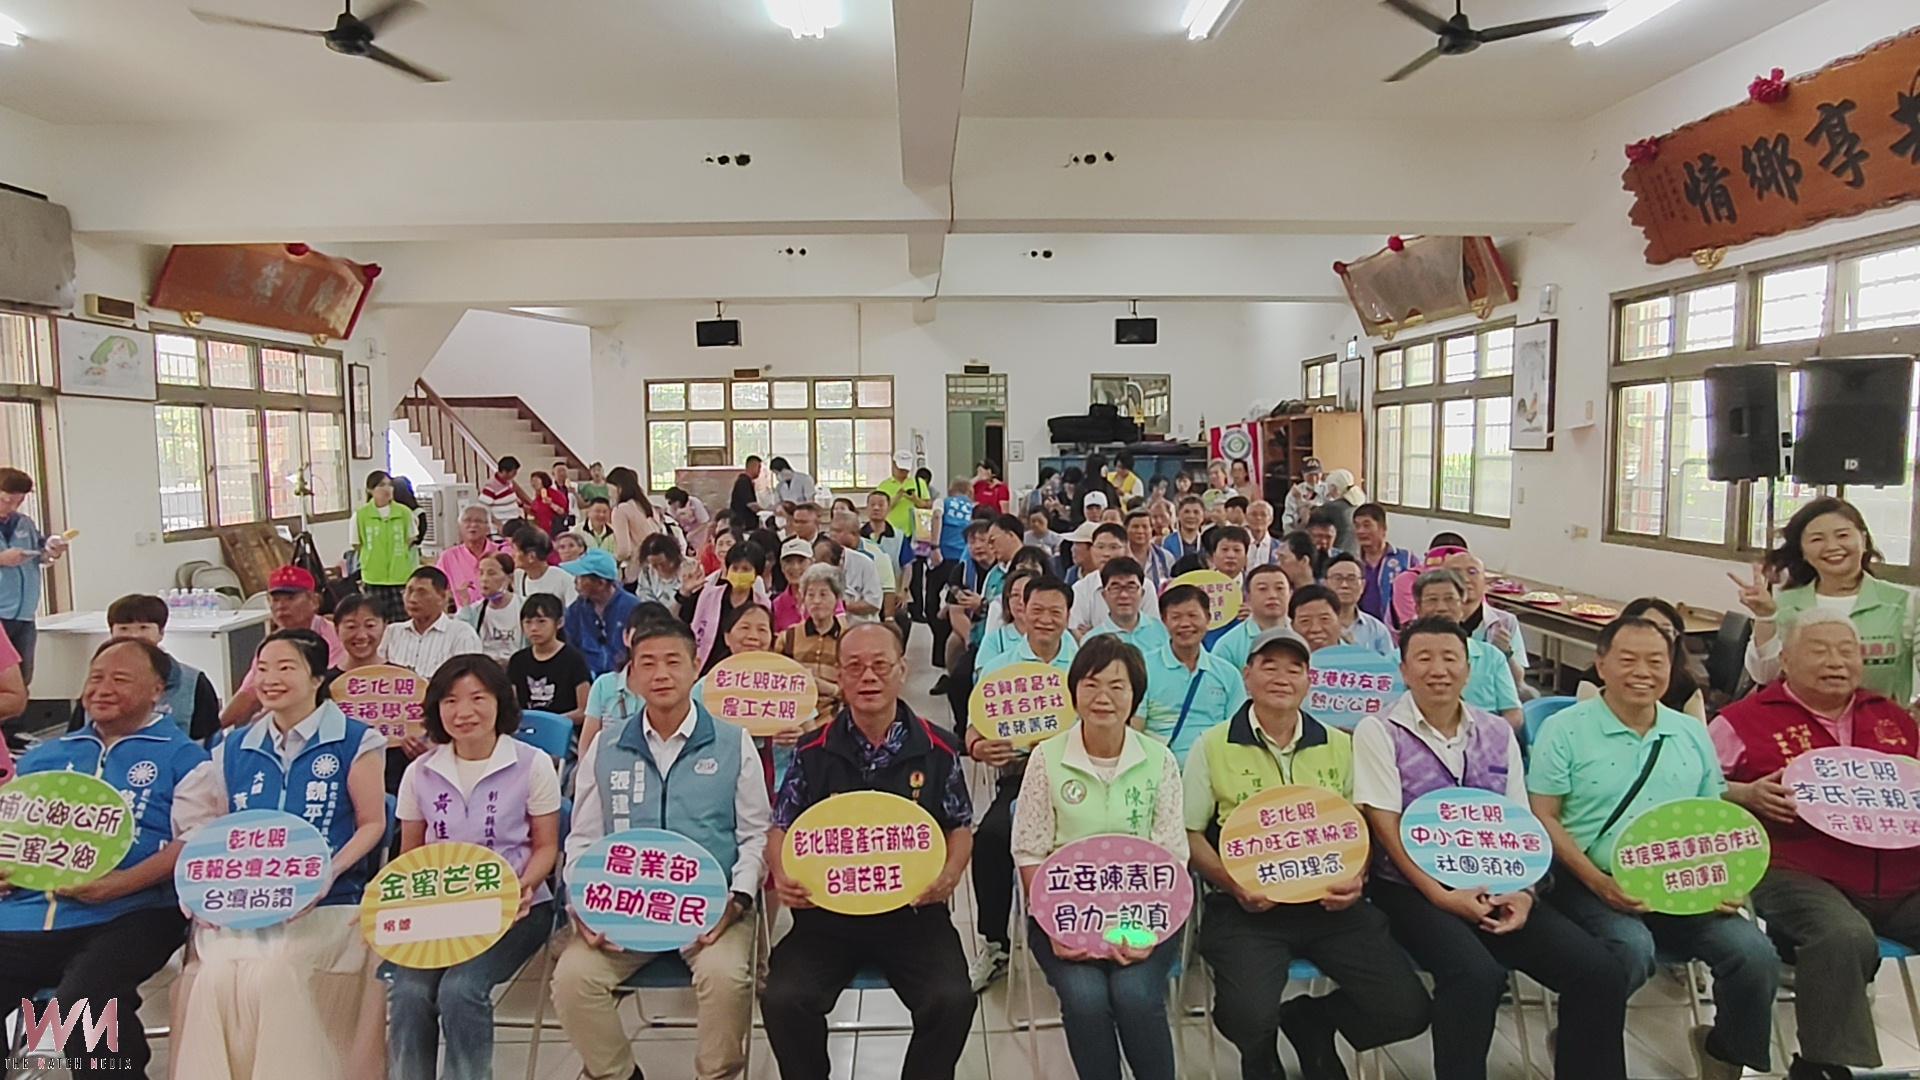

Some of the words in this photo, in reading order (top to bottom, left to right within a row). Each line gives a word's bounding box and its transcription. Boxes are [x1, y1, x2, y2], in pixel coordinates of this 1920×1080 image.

[346, 677, 415, 695] 彰化縣
[715, 669, 807, 692] 彰化縣政府
[985, 693, 1065, 718] 生產合作社
[1813, 757, 1898, 781] 彰化縣
[1259, 801, 1317, 827] 彰化縣
[1439, 802, 1504, 822] 彰化縣
[0, 832, 96, 871] 三蜜之鄉
[228, 827, 287, 850] 彰化縣
[794, 823, 931, 857] 彰化縣農產行銷協會
[1226, 821, 1359, 858] 活力旺企業協會
[1410, 826, 1541, 852] 中小企業協會
[605, 844, 699, 884] 農業部
[1047, 863, 1176, 892] 立委陳素月
[1257, 852, 1345, 884] 共同理念
[1435, 854, 1526, 877] 社團領袖
[379, 862, 501, 903] 金蜜芒果
[826, 864, 903, 895] 台灣芒果王
[584, 882, 707, 926] 協助農民
